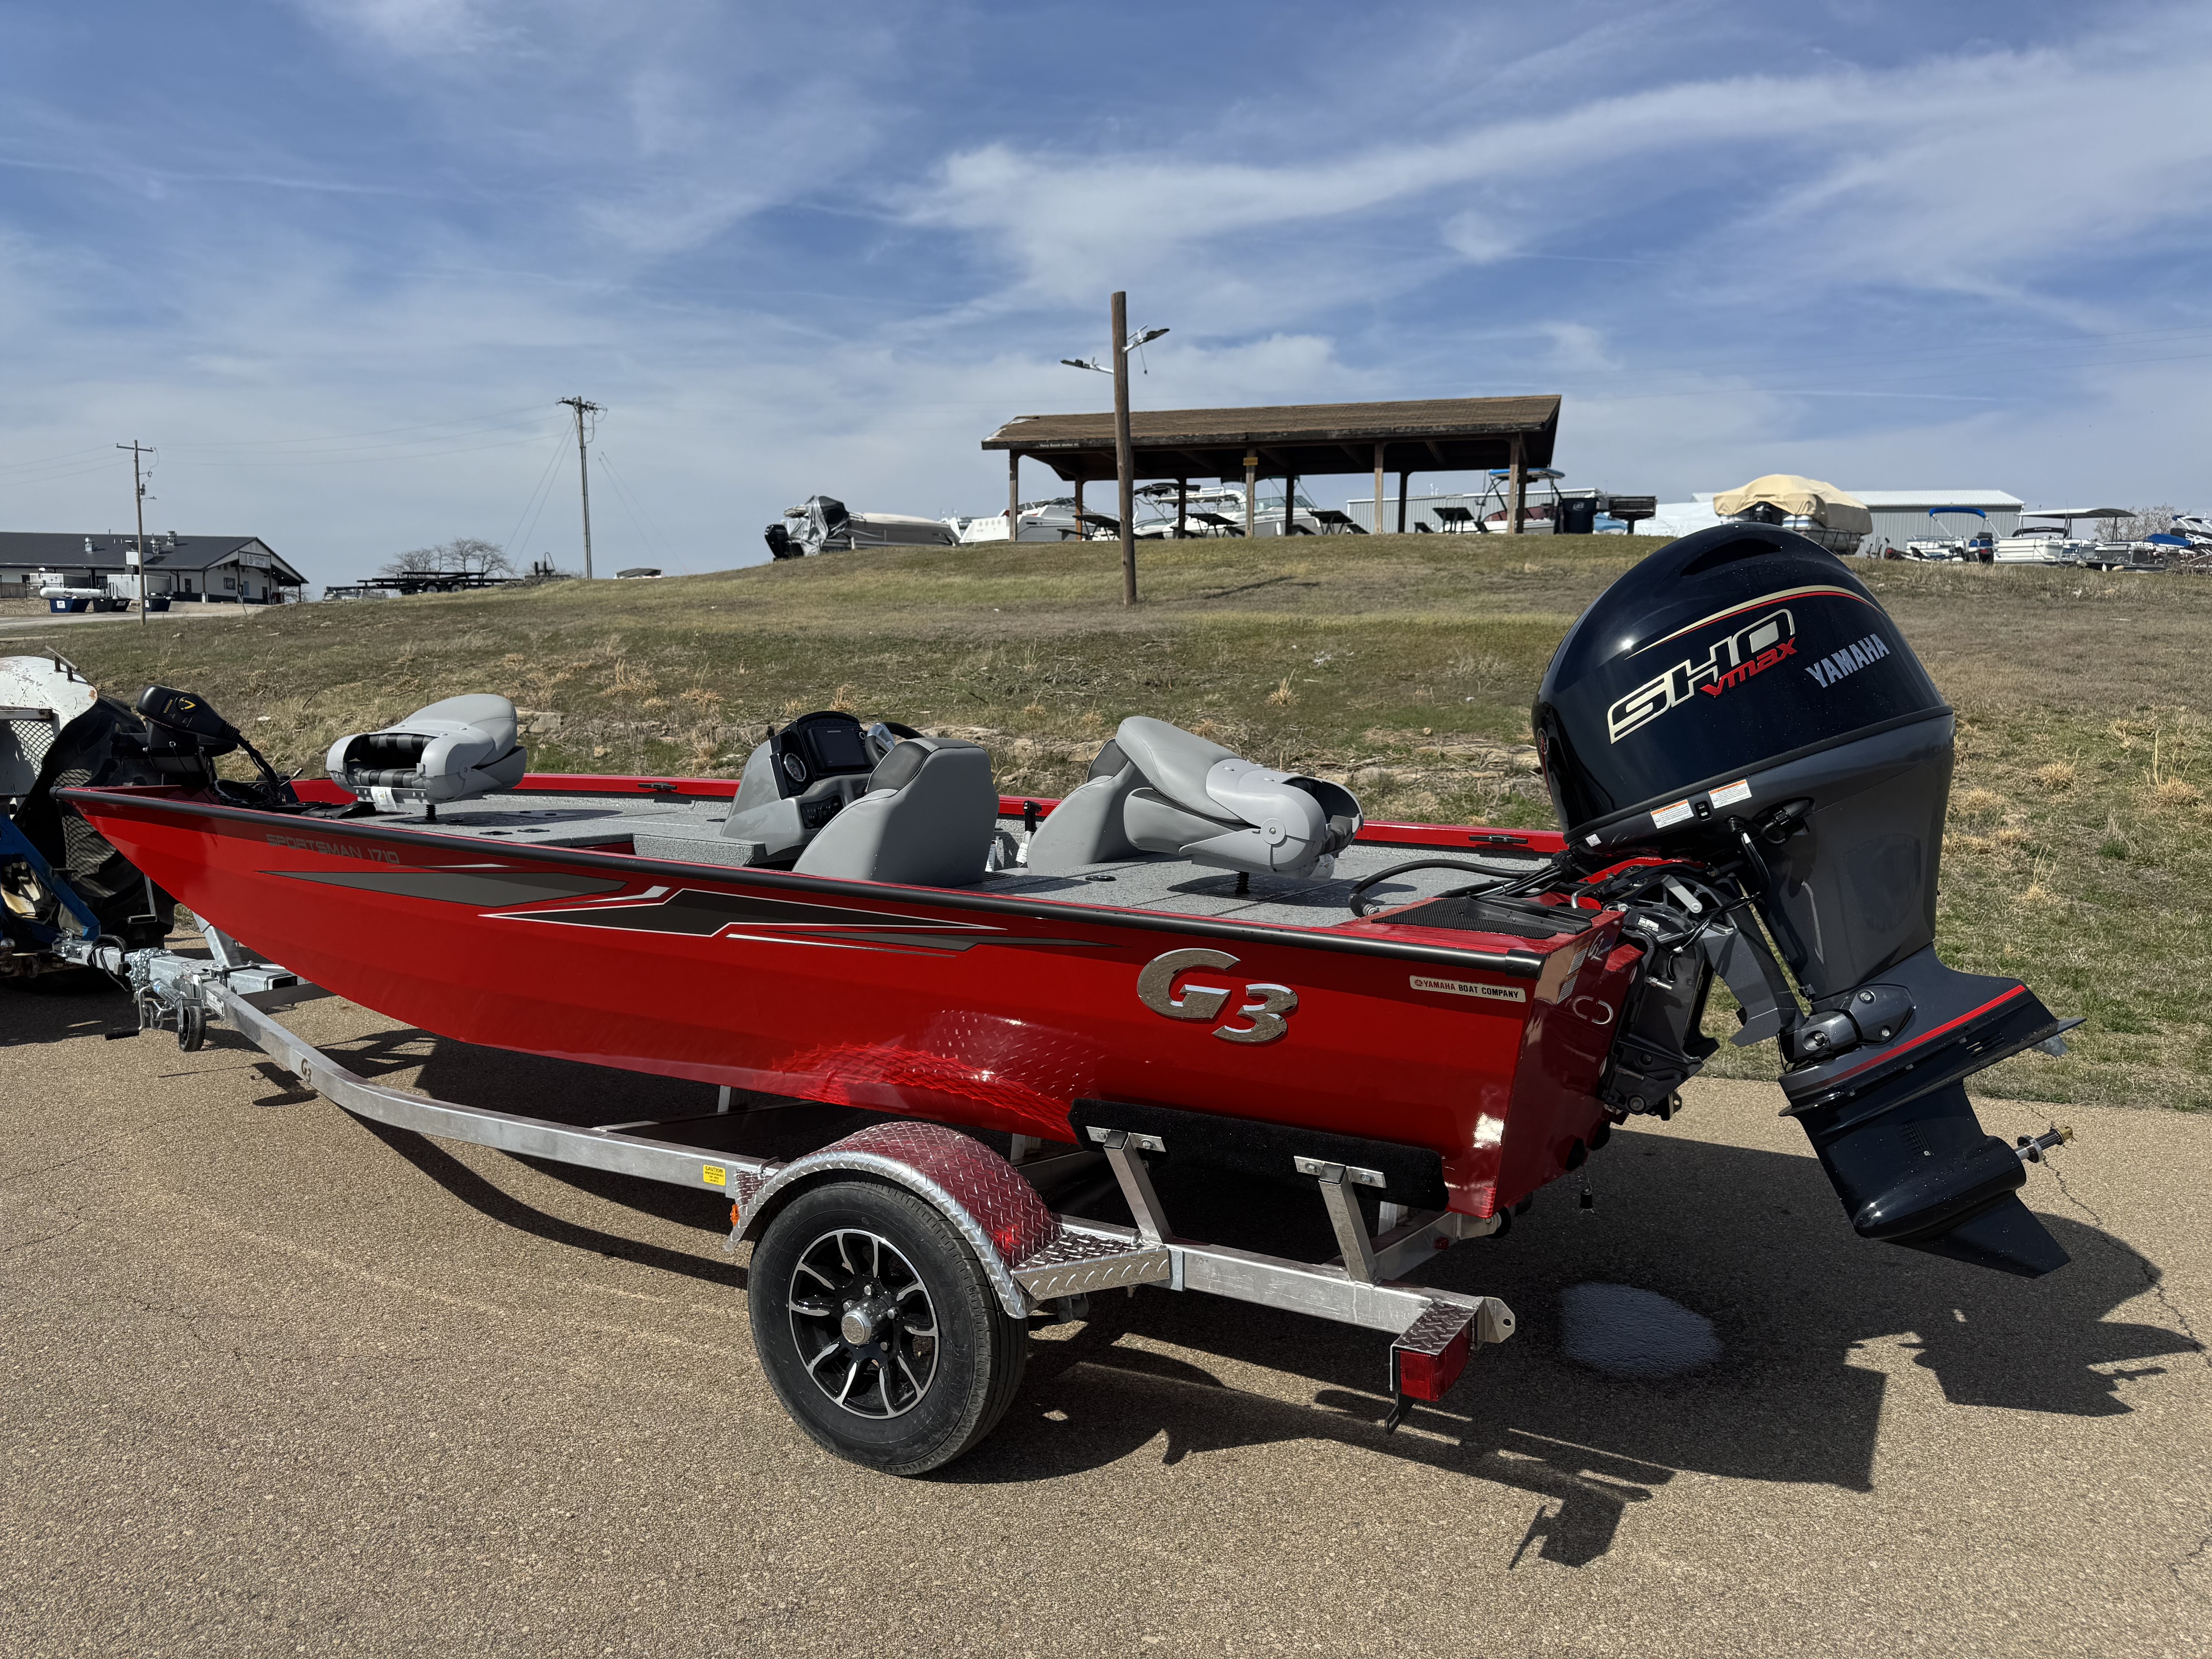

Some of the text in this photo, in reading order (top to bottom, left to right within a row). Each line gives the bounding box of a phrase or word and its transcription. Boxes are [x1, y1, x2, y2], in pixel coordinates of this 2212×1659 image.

[1607, 609, 1795, 744] SHO
[1804, 633, 1890, 688] YAMAHA
[266, 834, 400, 864] SPORTSMAN 1710
[1137, 948, 1298, 1042] G3
[1423, 980, 1518, 998] YAMAHA BOAT COMPANY
[301, 1058, 311, 1082] G3
